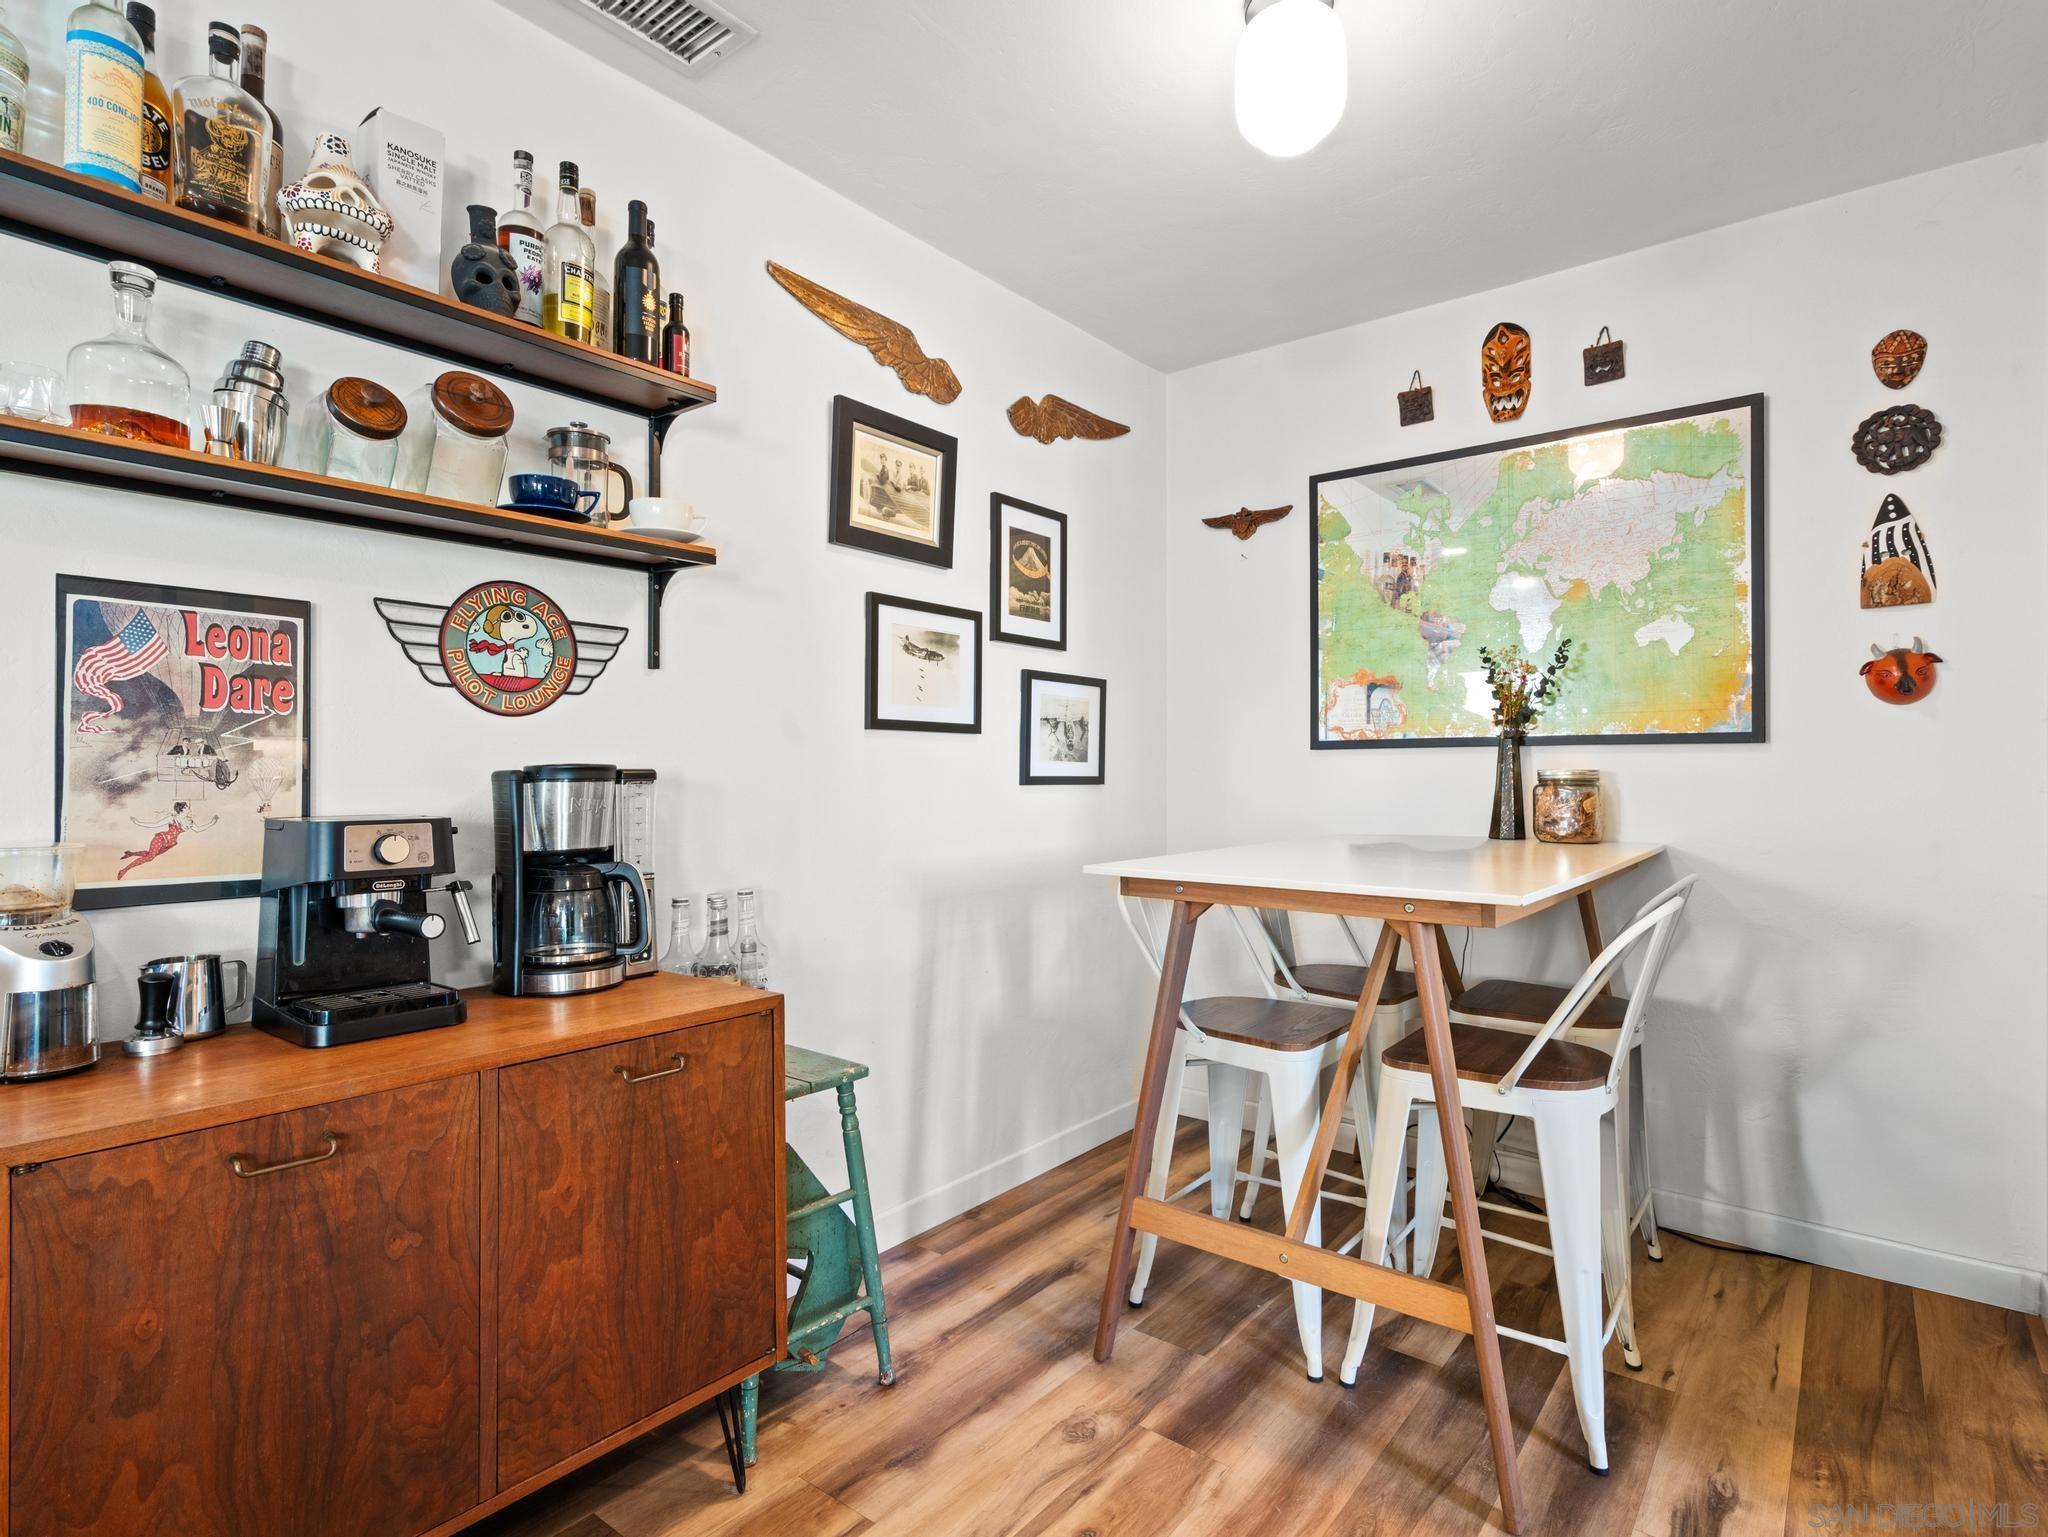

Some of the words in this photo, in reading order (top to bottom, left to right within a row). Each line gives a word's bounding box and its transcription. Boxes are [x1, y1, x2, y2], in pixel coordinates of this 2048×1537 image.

[87, 97, 104, 107] 400
[143, 105, 169, 133] ATE
[143, 155, 169, 168] BEL
[387, 142, 437, 169] KANOSUKE
[387, 150, 415, 166] SINGLE
[417, 161, 437, 174] MALT
[387, 163, 415, 178] SHERRY
[416, 174, 437, 187] CASKS
[400, 173, 426, 187] VATTED
[449, 587, 527, 632] FLYING
[532, 602, 567, 642] ACE
[180, 609, 292, 667] Leona
[199, 662, 295, 715] Dare
[447, 648, 497, 704] PILOT
[501, 656, 573, 711] LOUNGE
